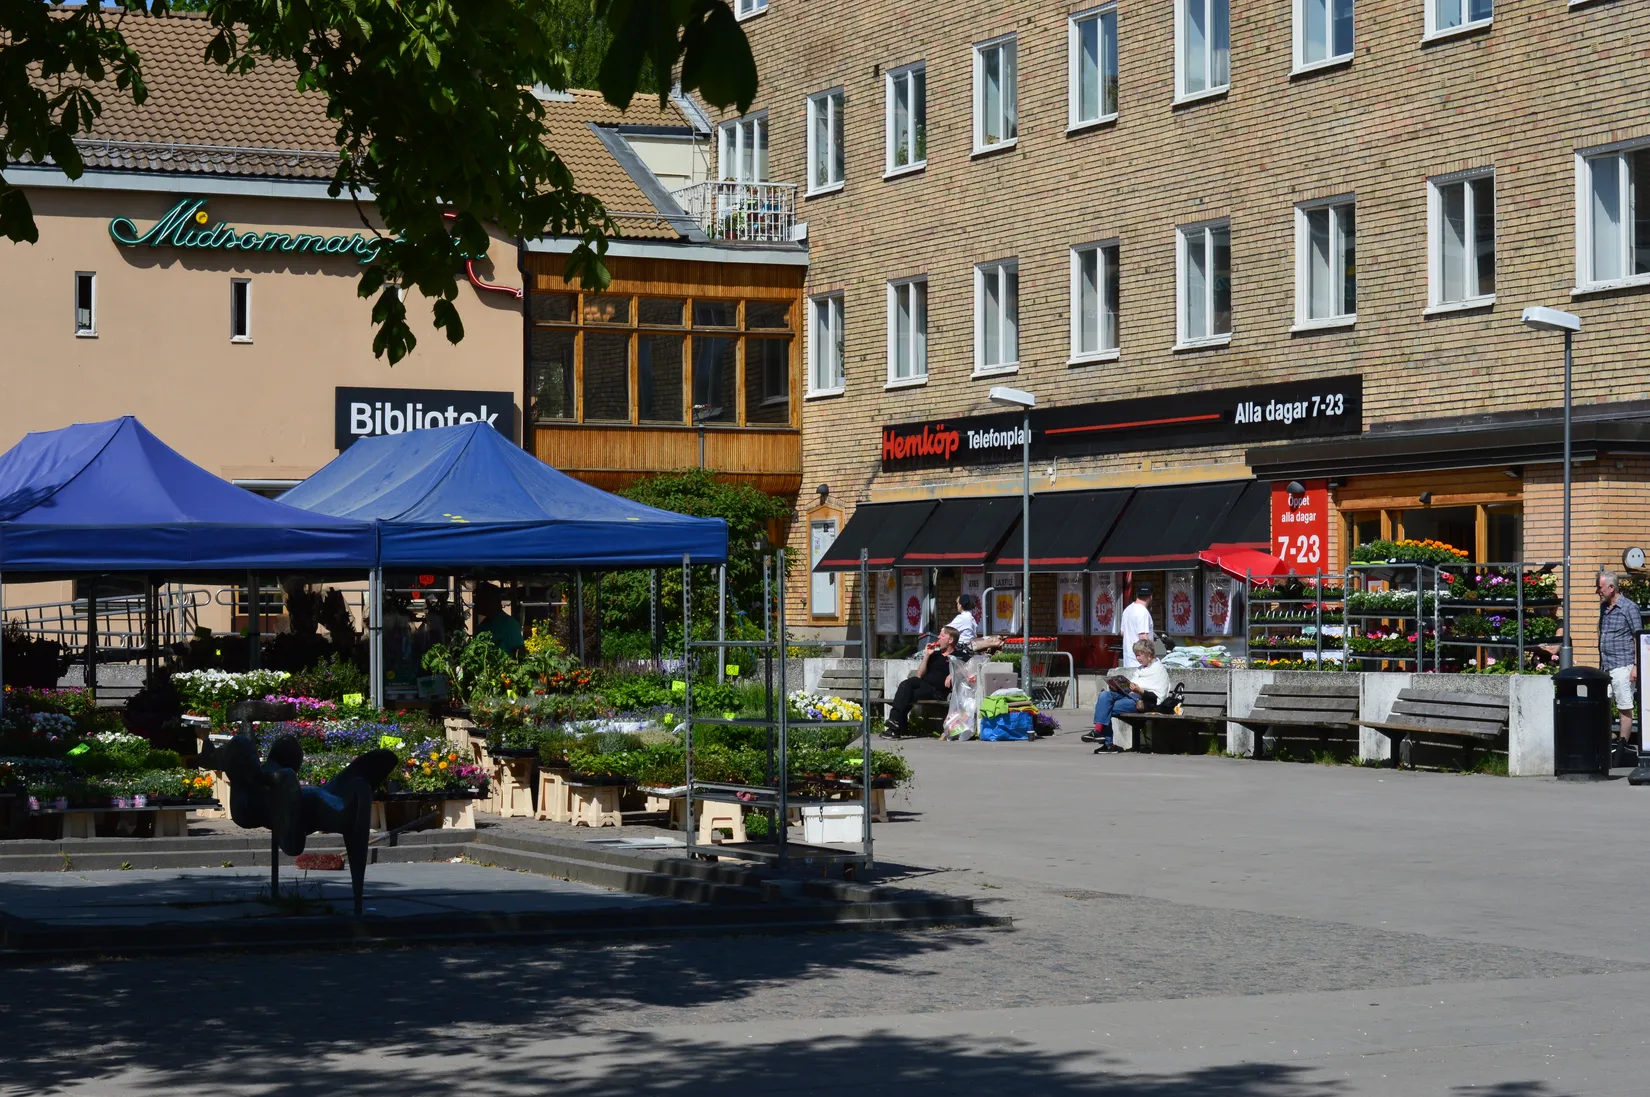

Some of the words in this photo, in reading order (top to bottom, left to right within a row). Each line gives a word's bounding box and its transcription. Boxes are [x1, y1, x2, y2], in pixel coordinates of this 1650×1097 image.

[1235, 401, 1262, 424] Alla
[1265, 399, 1309, 425] dagar
[1311, 393, 1344, 417] 7-23
[882, 423, 960, 460] Hemköp
[1288, 493, 1310, 508] Öppet
[1281, 511, 1295, 523] alla
[1295, 511, 1317, 524] dagar
[1278, 534, 1320, 563] 7-23
